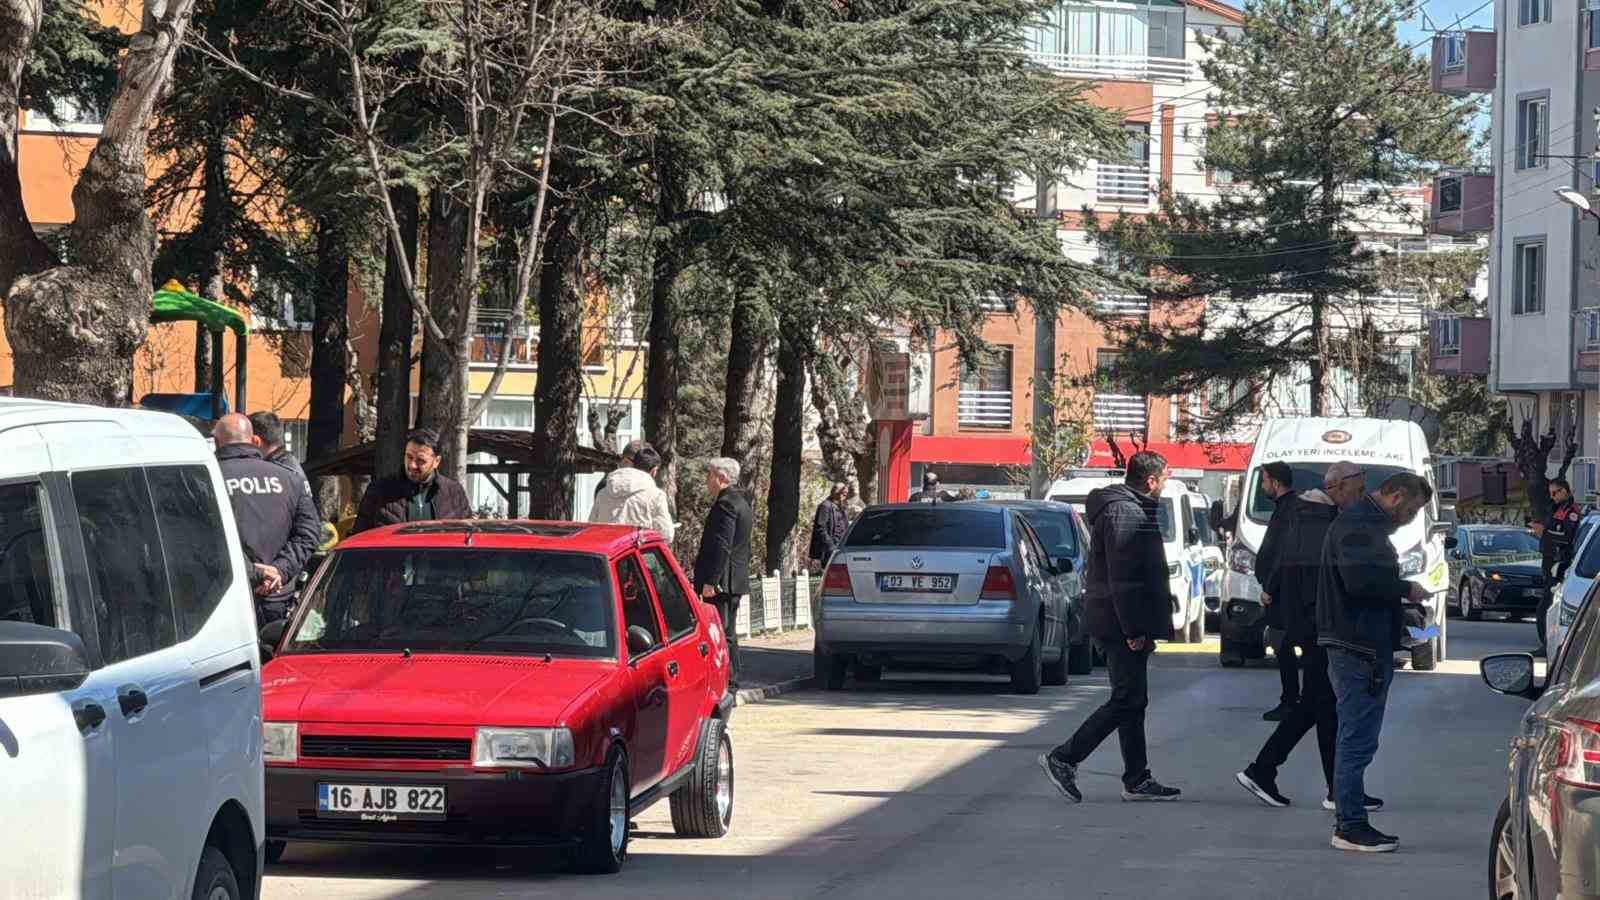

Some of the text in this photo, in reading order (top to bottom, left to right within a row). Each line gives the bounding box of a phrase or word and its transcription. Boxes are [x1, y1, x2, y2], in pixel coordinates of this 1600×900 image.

[1266, 449, 1293, 459] OLAY
[890, 575, 903, 587] 03
[330, 787, 352, 808] 16
[362, 788, 397, 809] AJB
[407, 789, 443, 811] 822
